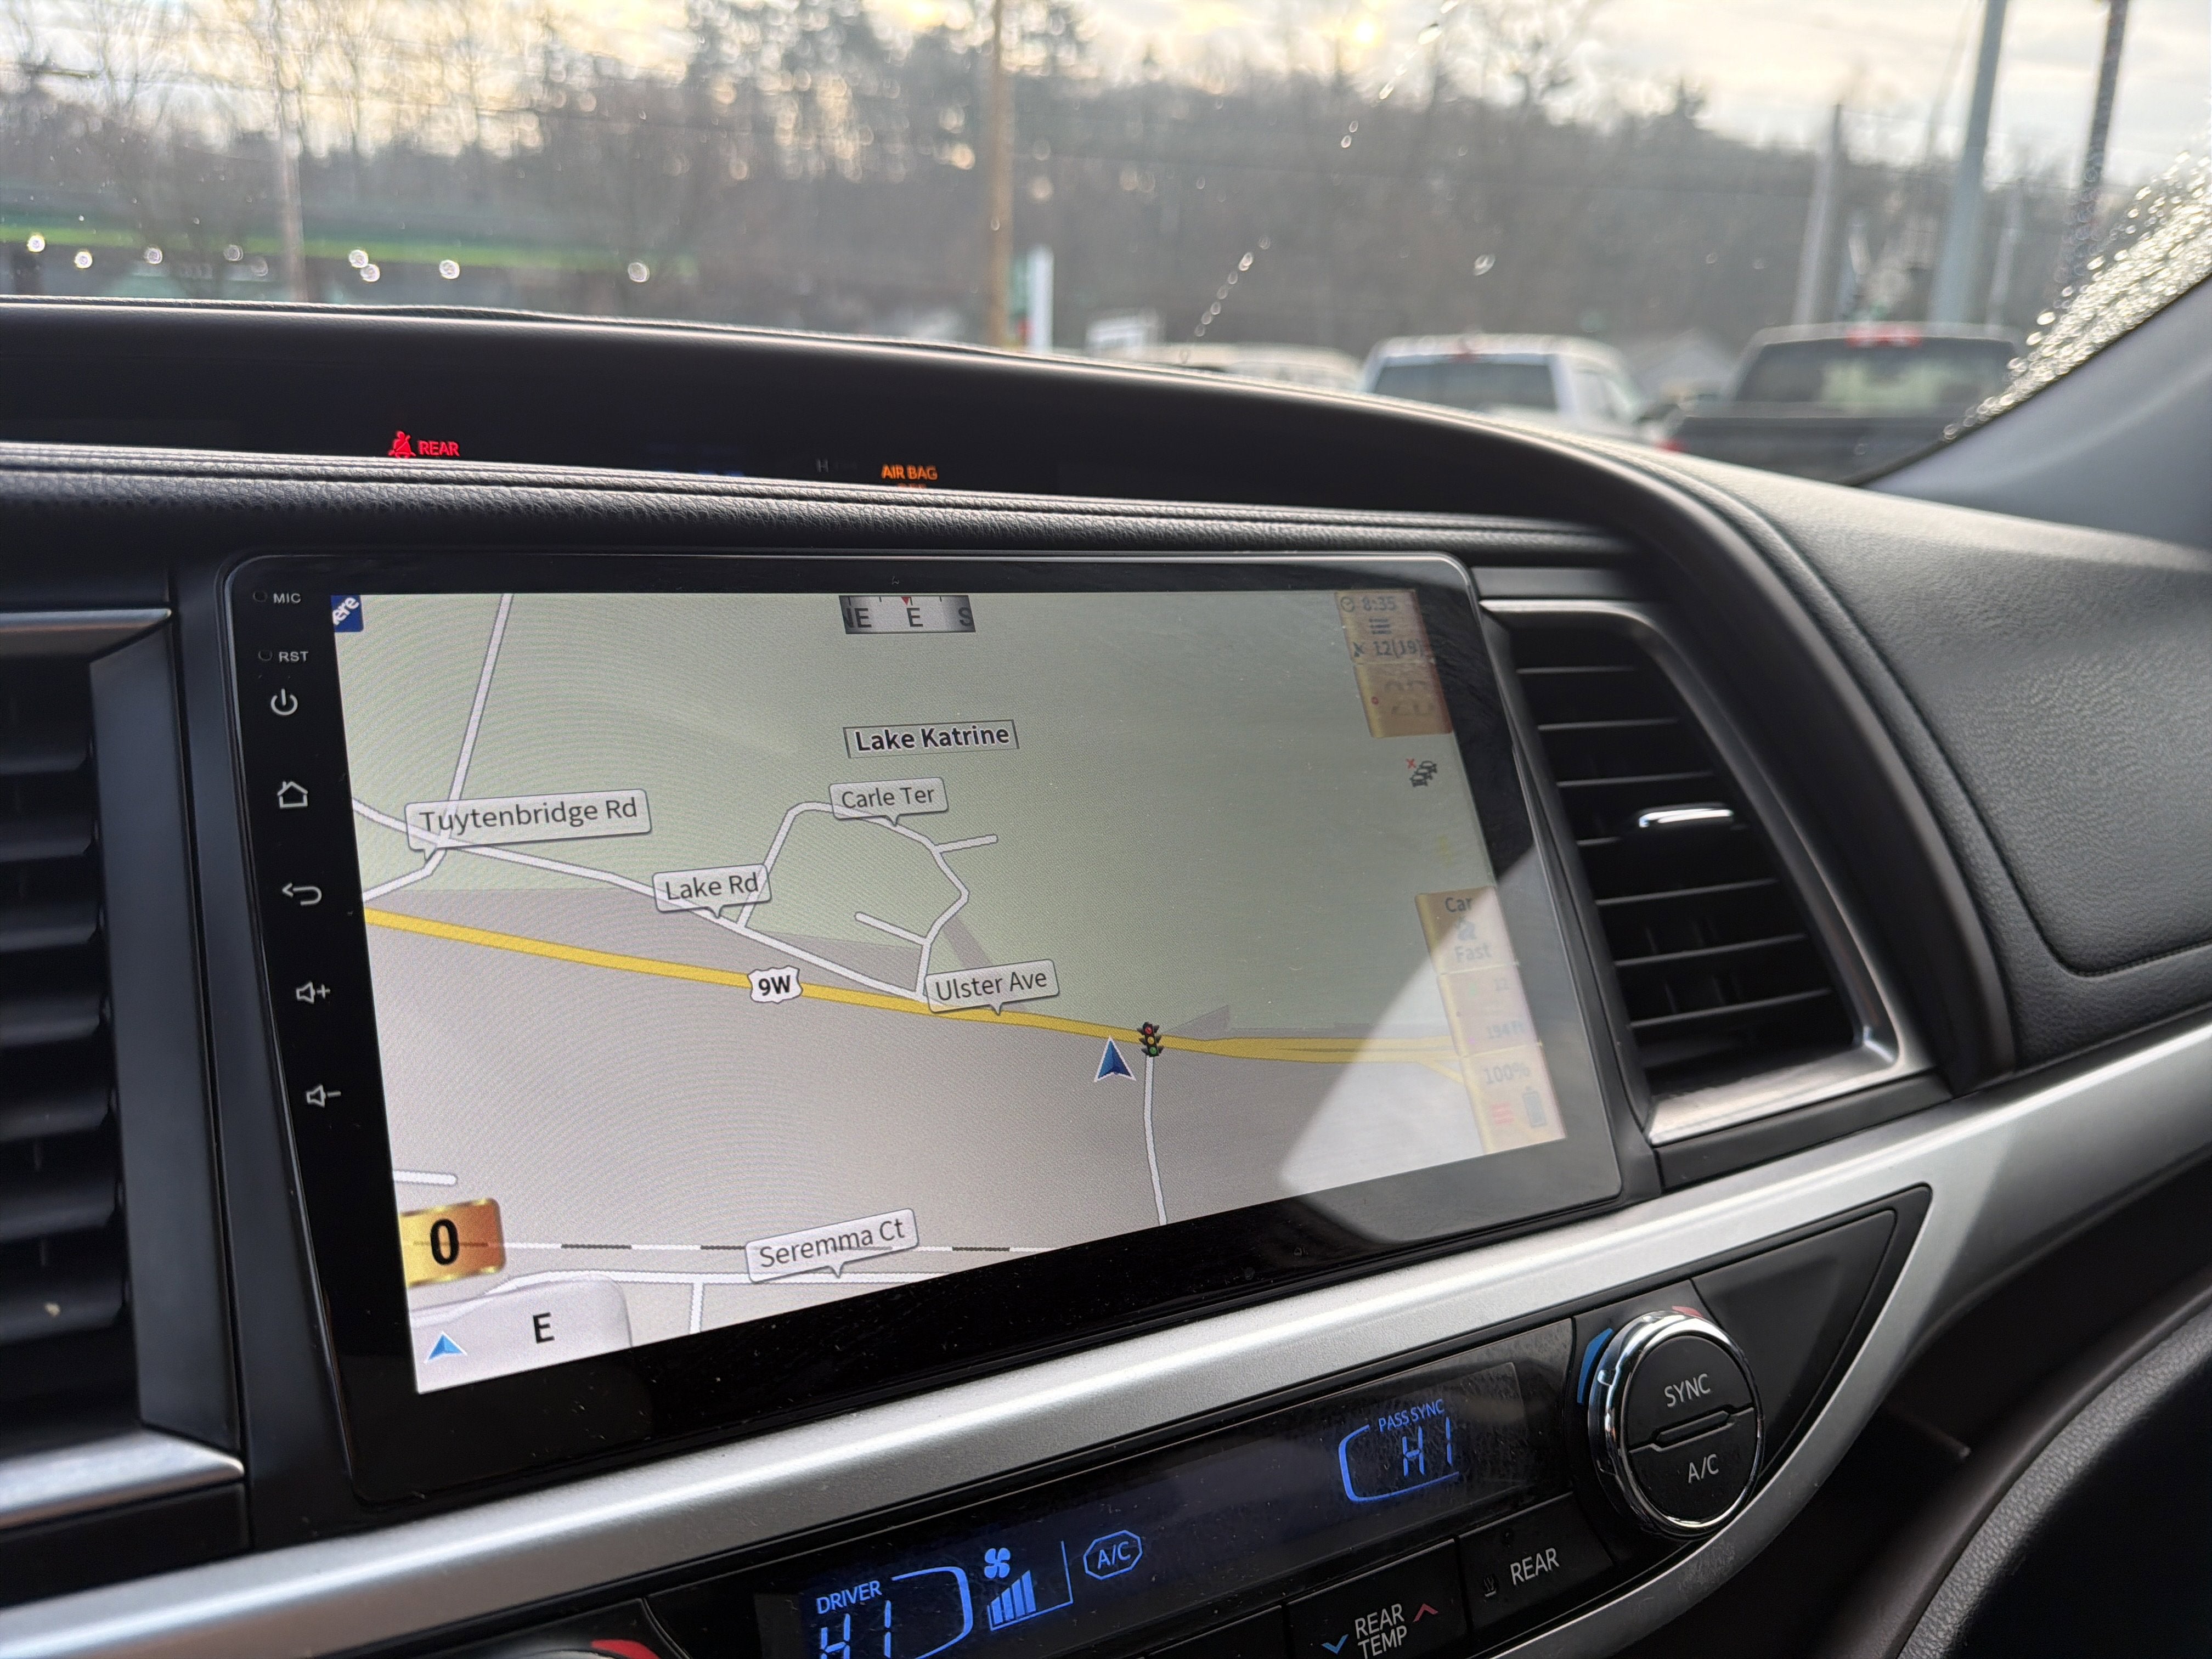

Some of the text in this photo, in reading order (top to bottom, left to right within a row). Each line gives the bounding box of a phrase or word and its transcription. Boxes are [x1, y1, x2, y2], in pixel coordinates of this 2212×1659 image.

[417, 440, 461, 456] REAR
[881, 464, 938, 481] AIR BAG
[273, 592, 302, 603] MIC
[332, 597, 360, 625] ere
[1362, 596, 1397, 611] 8:35
[906, 607, 924, 627] E
[279, 651, 309, 662] RST
[855, 725, 1009, 751] Lake Katrine
[841, 787, 934, 809] Carle Ter
[419, 797, 637, 836] Tuytenbridge Rd
[665, 872, 759, 900] Lake Rd
[1444, 897, 1474, 913] Car
[1454, 942, 1492, 963] Fast
[758, 975, 791, 996] 9W
[935, 971, 1047, 1001] Ulster Ave
[1483, 1062, 1531, 1085] 100%
[430, 1218, 460, 1266] 0
[760, 1218, 905, 1267] Seremma Ct
[532, 1312, 555, 1344] E
[1664, 1373, 1711, 1408] SYNC
[1378, 1398, 1445, 1433] PASS SYNC
[1688, 1454, 1719, 1483] A/C
[1097, 1540, 1131, 1570] A/C
[1510, 1547, 1560, 1585] REAR
[816, 1580, 882, 1615] DRIVER
[1355, 1603, 1405, 1640] REAR
[1358, 1624, 1408, 1659] TEMP
